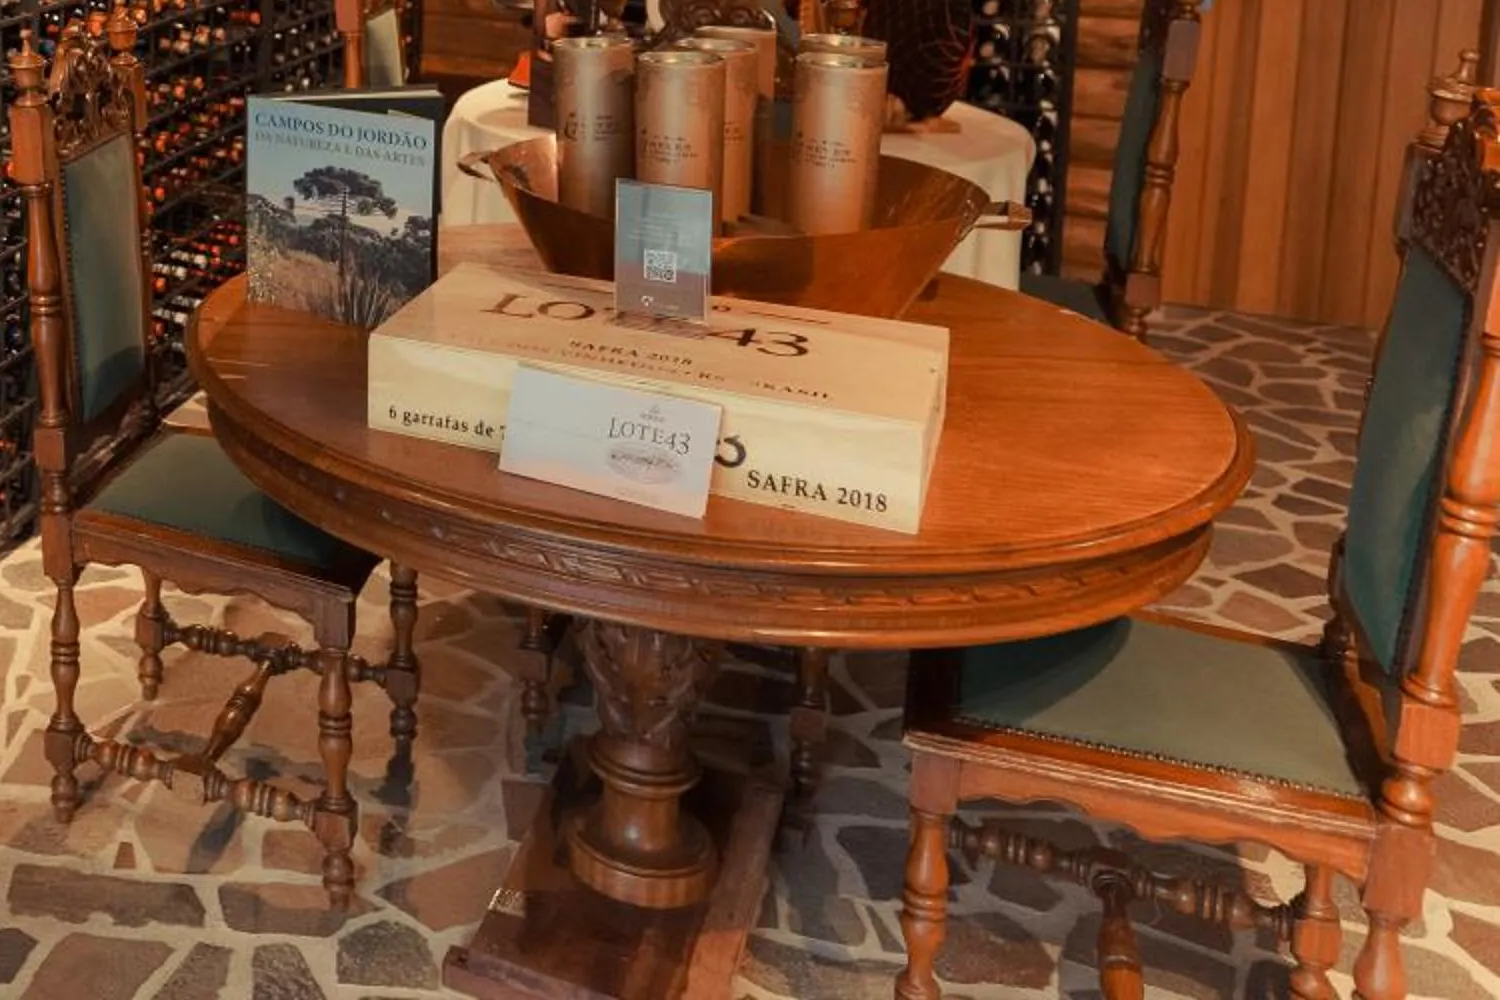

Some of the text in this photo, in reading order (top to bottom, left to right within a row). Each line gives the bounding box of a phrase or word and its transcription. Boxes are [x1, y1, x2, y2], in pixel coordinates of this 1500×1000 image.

[255, 112, 428, 149] CAMPOS DO JORDÃO
[275, 132, 342, 154] NATUREZA
[569, 339, 693, 366] SAFRA 2018
[388, 405, 397, 420] 6
[402, 410, 469, 433] garrafas
[474, 419, 495, 438] de
[747, 469, 888, 513] SAFRA 2018
